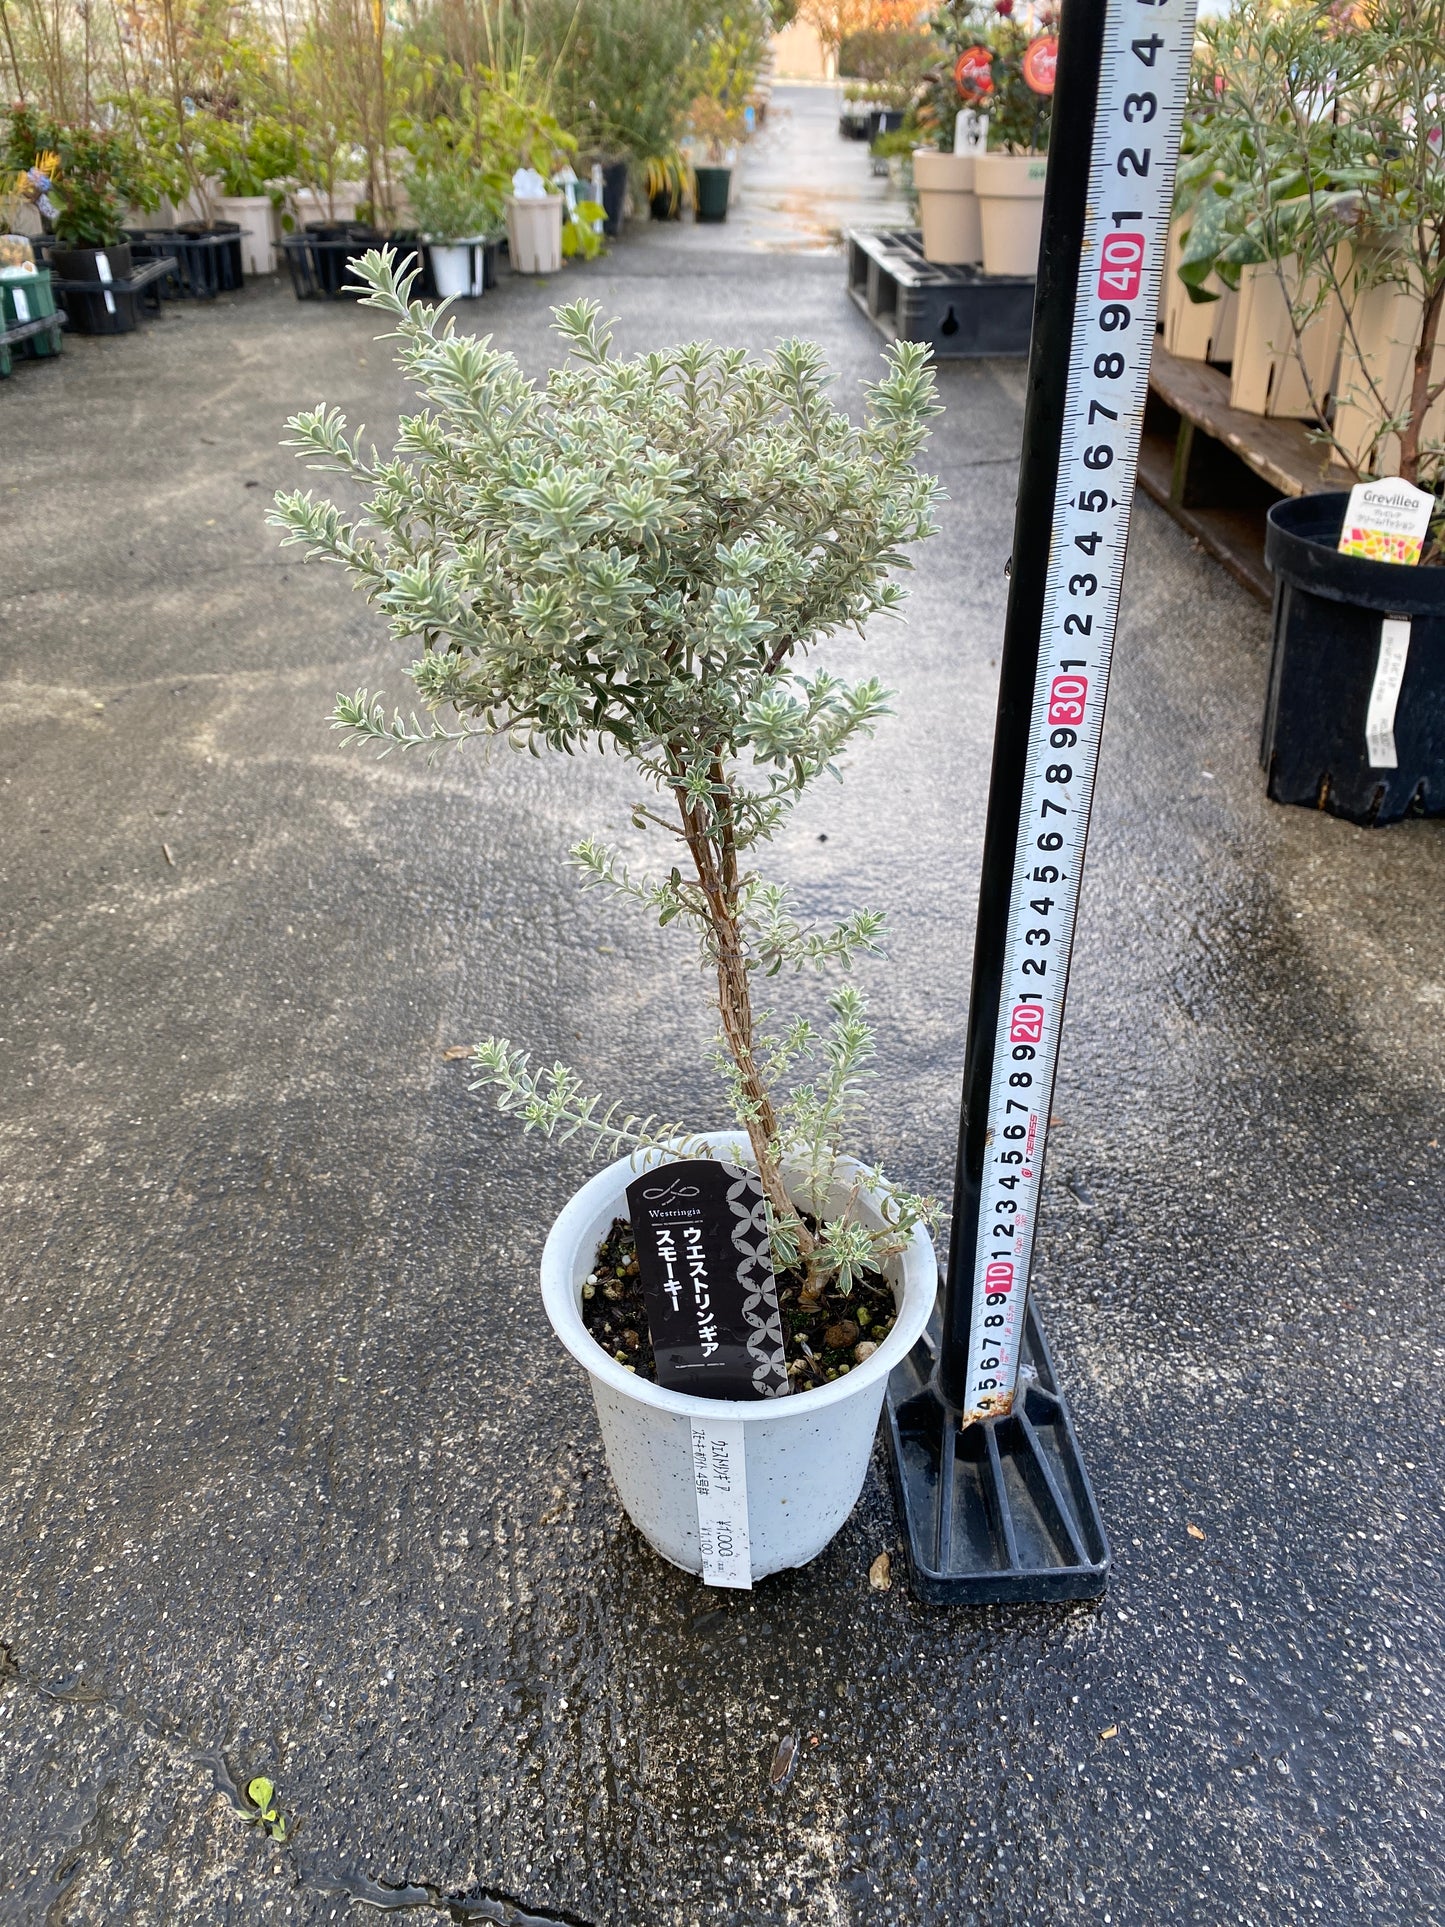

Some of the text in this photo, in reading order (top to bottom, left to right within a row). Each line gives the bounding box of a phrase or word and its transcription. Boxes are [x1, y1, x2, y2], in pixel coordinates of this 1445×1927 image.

[1131, 33, 1165, 66] 4
[1123, 91, 1158, 123] 3
[1117, 148, 1151, 177] 2
[1112, 211, 1143, 229] 1
[1103, 240, 1141, 292] 40
[1099, 307, 1131, 332] 9
[1094, 352, 1124, 379] 8
[1088, 400, 1118, 425] 7
[1084, 445, 1114, 470] 6
[1079, 488, 1108, 512] 5
[1364, 490, 1419, 508] Grevillea
[1074, 532, 1102, 556] 4
[1069, 573, 1097, 596] 3
[1064, 614, 1093, 635] 2
[1060, 660, 1086, 672] 1
[1050, 681, 1085, 718] 30
[1050, 728, 1077, 748] 9
[1046, 763, 1072, 783] 8
[1041, 799, 1067, 818] 7
[1037, 832, 1063, 851] 6
[1033, 866, 1059, 883] 5
[1030, 897, 1054, 916] 4
[1026, 928, 1051, 946] 3
[1022, 959, 1047, 976] 2
[1019, 994, 1042, 1003] 1
[1012, 1008, 1042, 1038] 20
[1012, 1045, 1036, 1060] 9
[1009, 1072, 1032, 1088] 8
[1006, 1099, 1029, 1114] 7
[1003, 1125, 1026, 1140] 6
[1001, 1151, 1023, 1165] 5
[999, 1175, 1020, 1190] 4
[648, 1208, 701, 1219] Westringia
[996, 1200, 1017, 1214] 3
[993, 1224, 1014, 1237] 2
[991, 1251, 1011, 1259] 1
[656, 1229, 683, 1312] スモーキー
[988, 1266, 1012, 1289] 10
[683, 1226, 720, 1358] ウエストリンギア
[986, 1293, 1006, 1306] 9
[985, 1315, 1005, 1327] 8
[983, 1338, 1002, 1350] 7
[980, 1358, 999, 1370] 6
[979, 1378, 997, 1390] 5
[977, 1398, 996, 1410] 4
